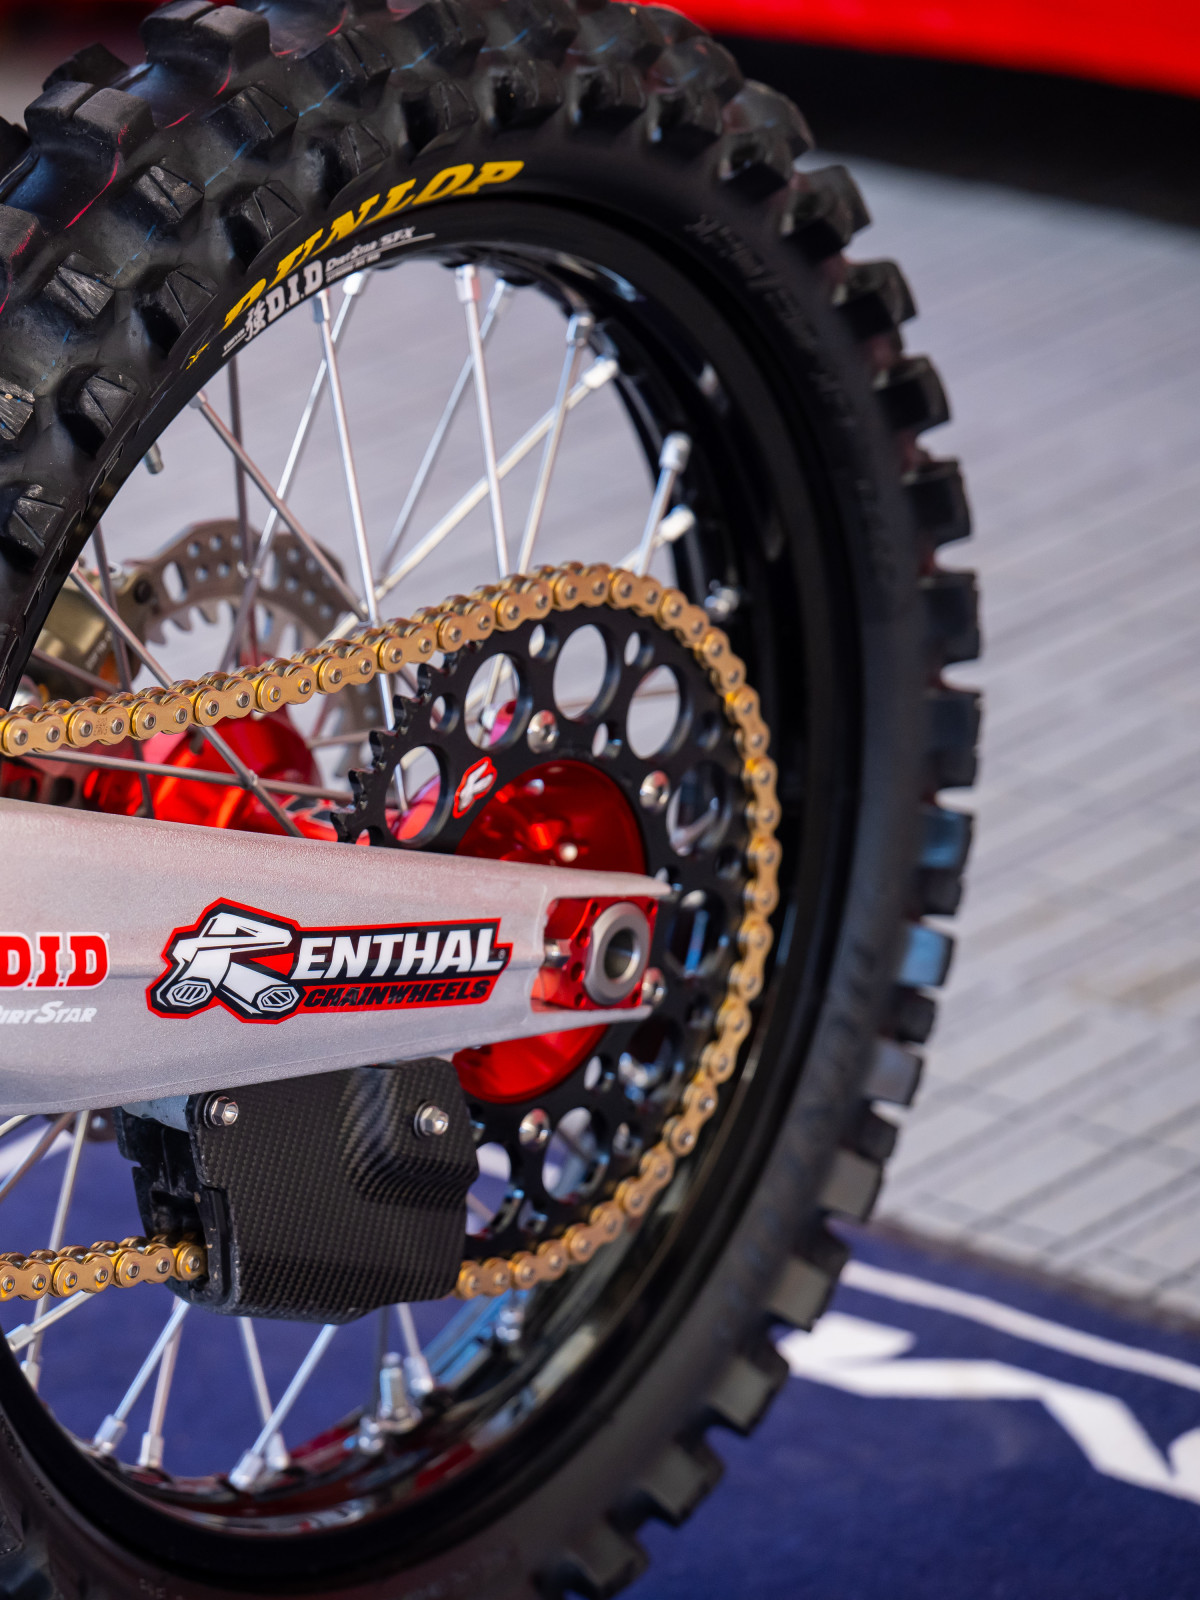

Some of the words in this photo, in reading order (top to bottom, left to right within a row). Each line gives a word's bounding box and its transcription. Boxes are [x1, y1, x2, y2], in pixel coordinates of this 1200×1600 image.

[219, 160, 525, 332] DUNLOP
[156, 912, 505, 1014] RENTHAL
[302, 979, 491, 1008] CHAINWHEELS
